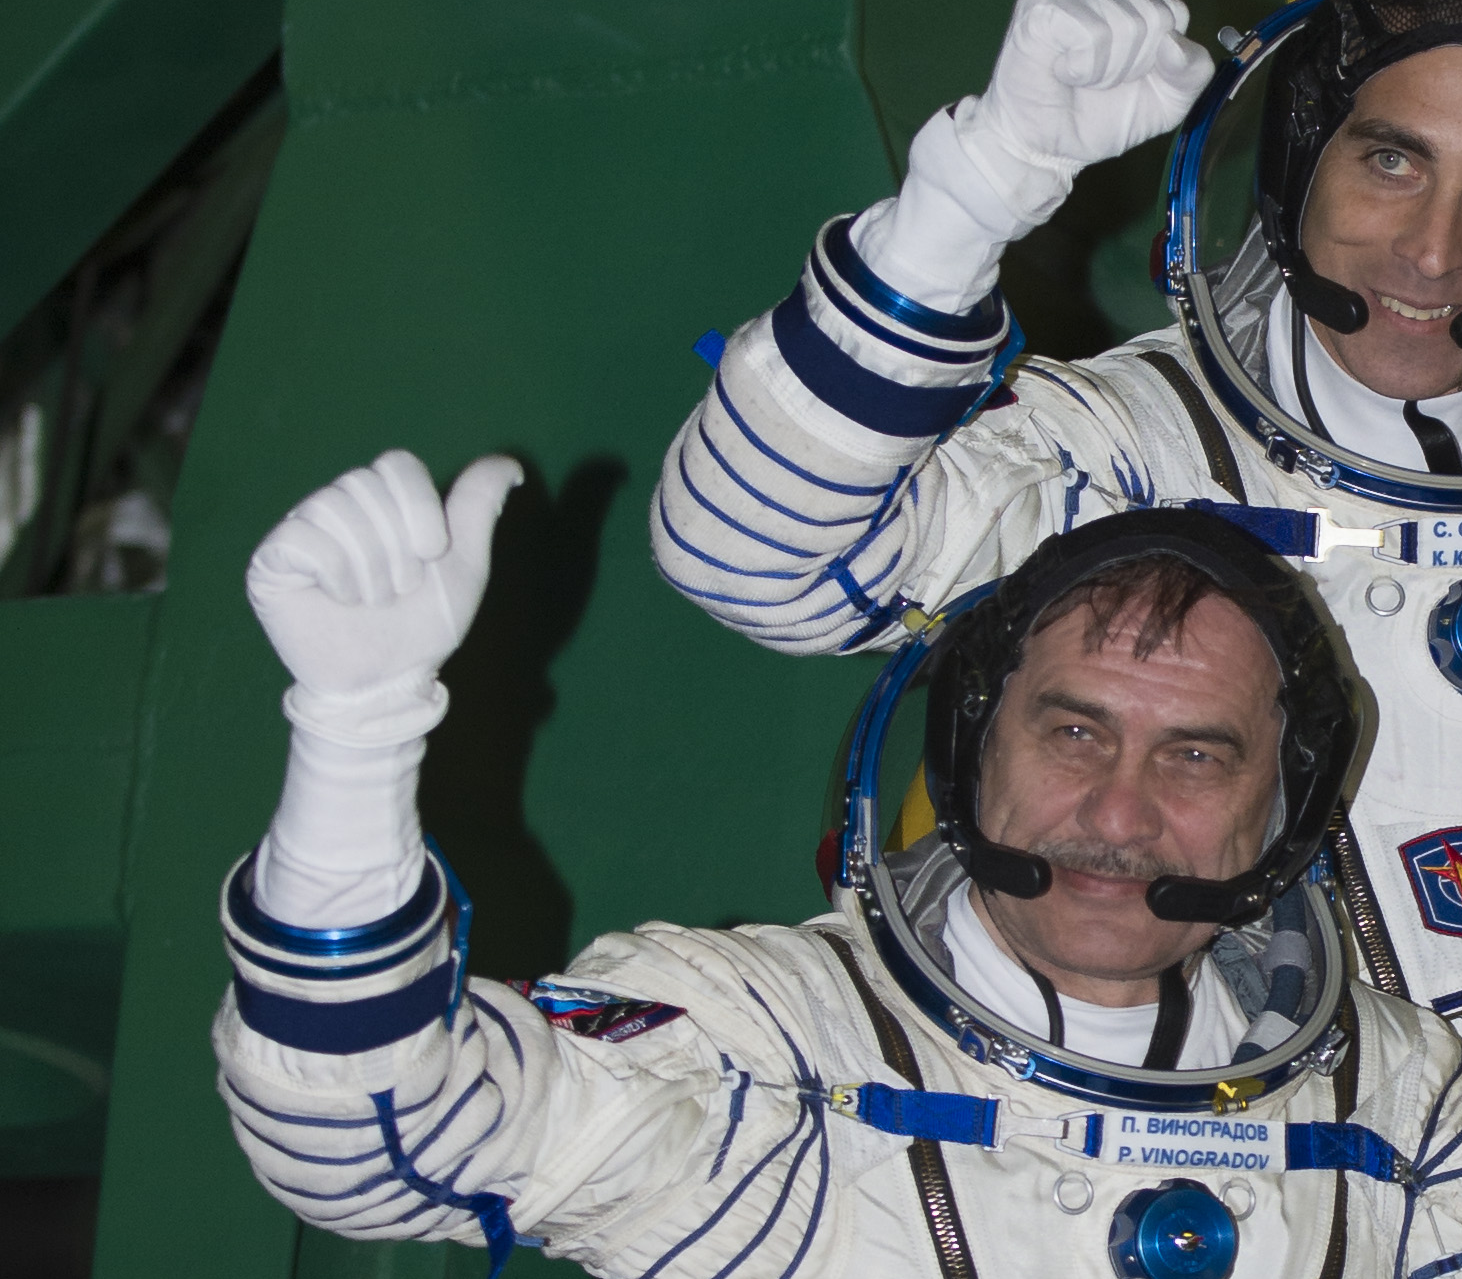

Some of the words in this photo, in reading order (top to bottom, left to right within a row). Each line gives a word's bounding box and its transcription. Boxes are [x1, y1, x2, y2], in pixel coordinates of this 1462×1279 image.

[1433, 521, 1452, 538] C.
[1432, 550, 1448, 566] К.
[1121, 1116, 1141, 1133] П.
[1146, 1117, 1269, 1143] ВИНОГРАДОВ
[1118, 1146, 1136, 1164] P.
[1141, 1147, 1270, 1170] VINOGRADOV
